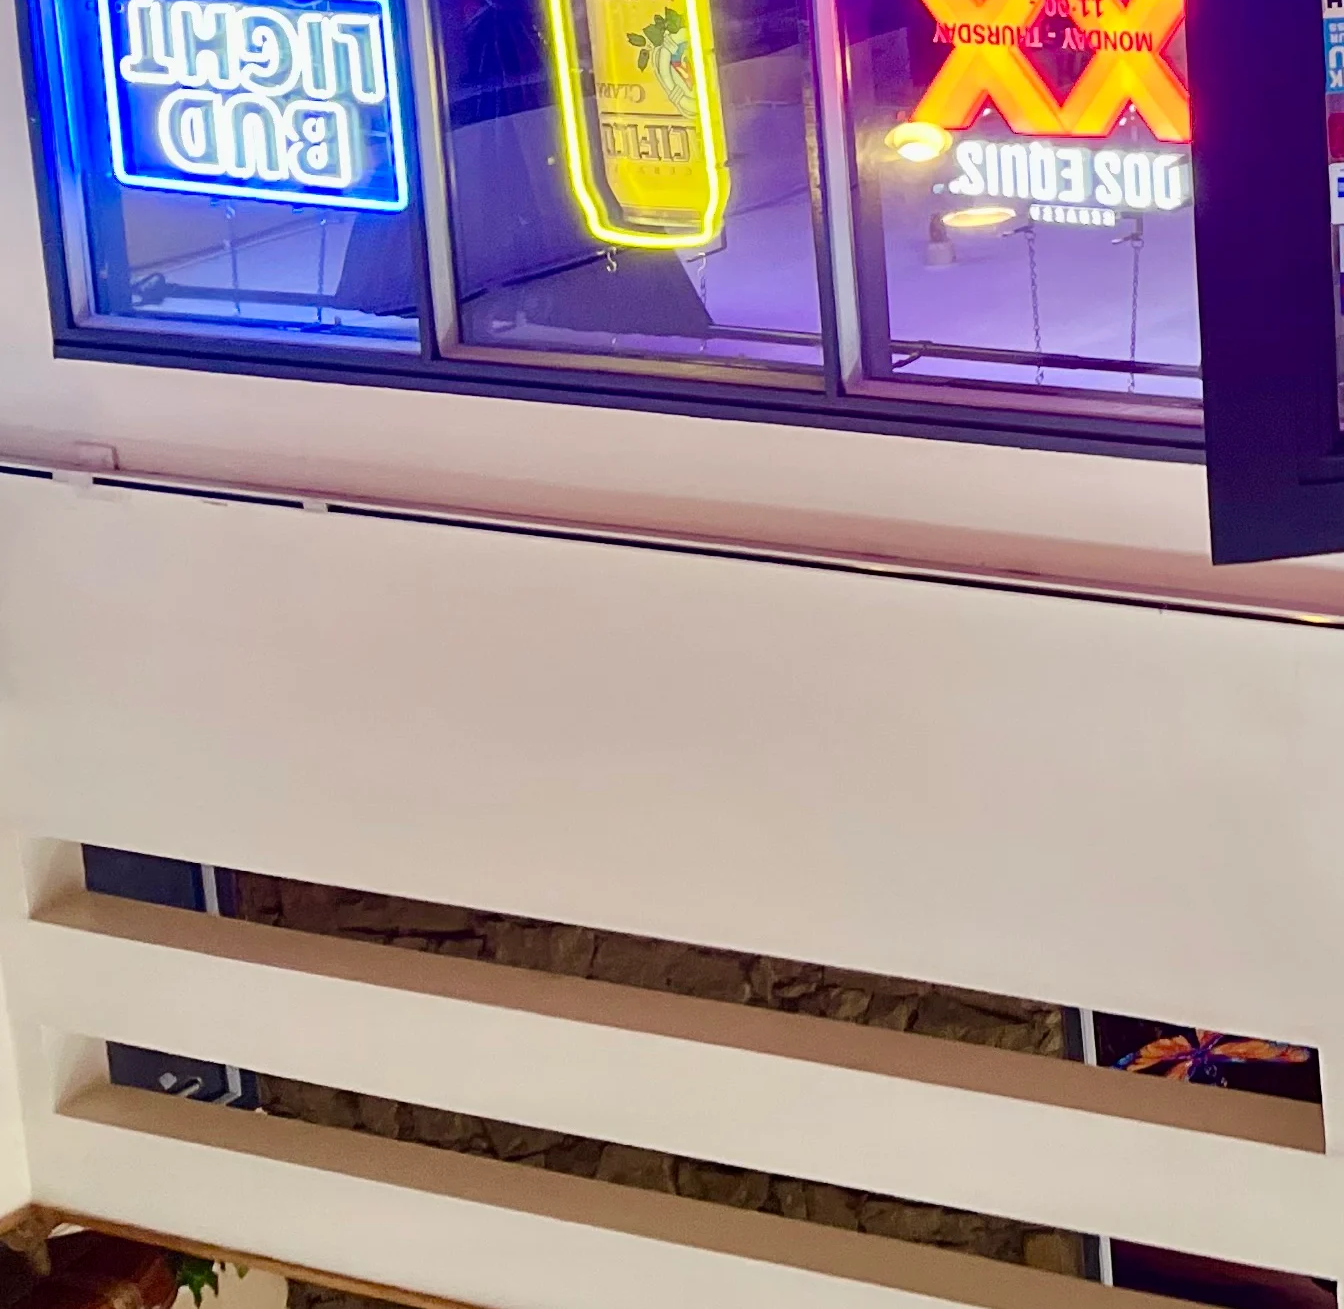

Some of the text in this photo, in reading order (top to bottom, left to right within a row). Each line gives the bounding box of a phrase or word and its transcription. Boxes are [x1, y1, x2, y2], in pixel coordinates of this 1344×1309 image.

[932, 22, 1153, 53] MONDAY THURSDAY
[156, 87, 352, 189] BUD
[948, 140, 1183, 210] DOS EQUIS
